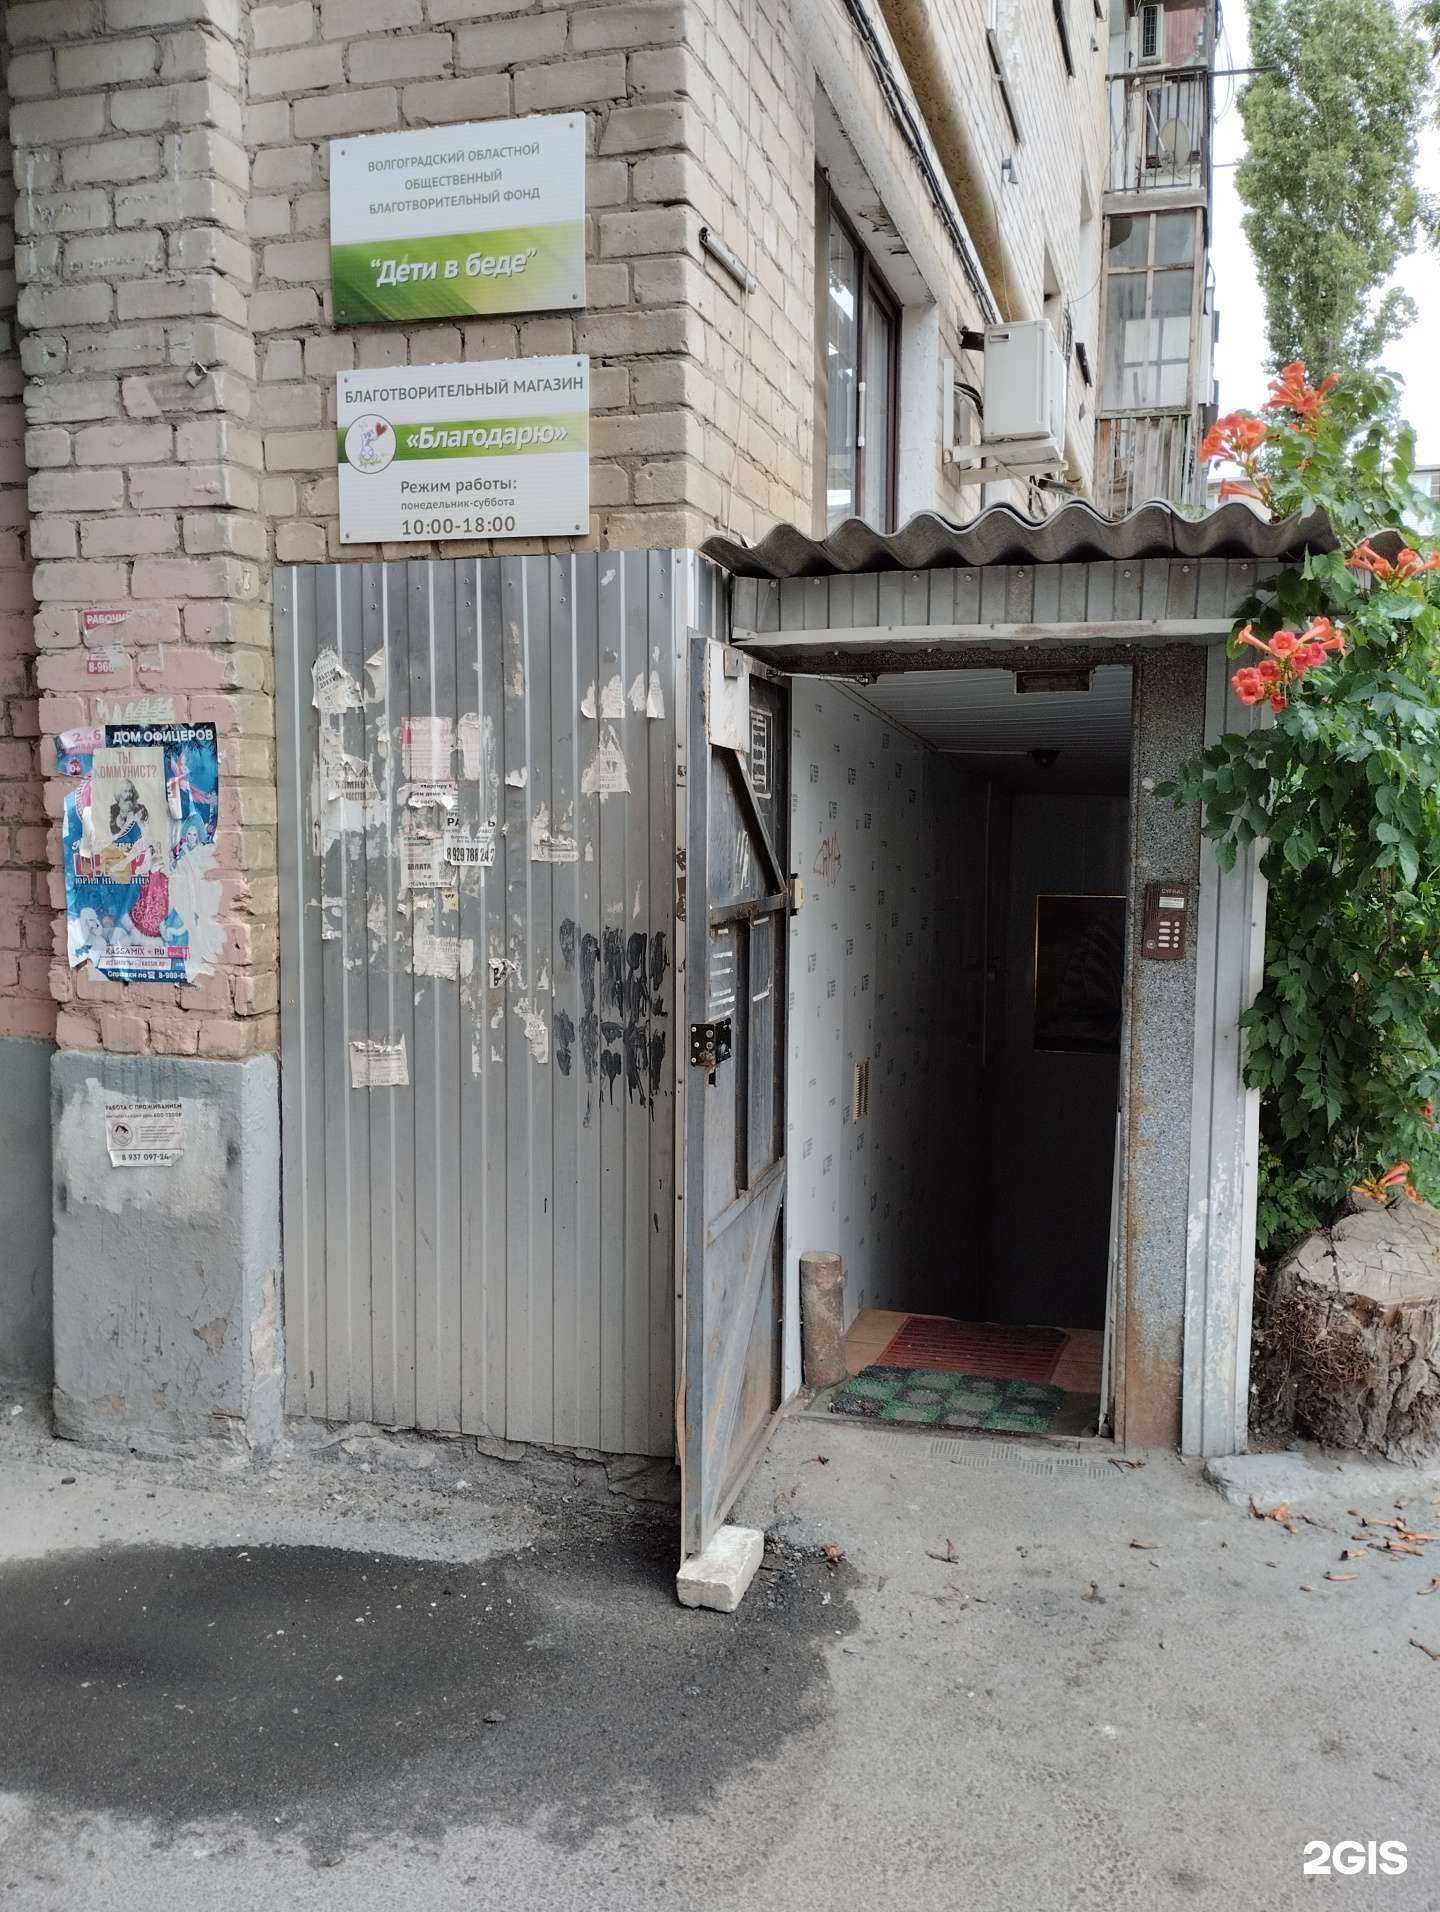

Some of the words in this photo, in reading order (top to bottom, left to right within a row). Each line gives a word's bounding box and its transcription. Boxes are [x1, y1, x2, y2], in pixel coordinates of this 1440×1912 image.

[367, 150, 465, 172] ВОЛГОГРАДСКИЙ
[467, 142, 540, 161] ОБЛАСТНОЙ
[404, 170, 503, 190] ОБЩЕСТВЕННЫЙ
[368, 190, 501, 215] БЛАГОТВОРИТЕЛЬНЫЙ
[503, 187, 541, 201] ФОНД
[444, 259, 459, 279] в
[345, 379, 509, 404] БЛАГОТВОРИТЕЛЬНЫЙ
[513, 376, 584, 393] МАГАЗИН
[406, 424, 569, 449] «Благодарю»
[400, 479, 451, 493] Режим
[455, 477, 517, 500] работы:
[400, 497, 515, 511] понедельник-суббота
[401, 515, 516, 535] 10:00-18:00
[112, 731, 141, 744] ДОМ
[144, 729, 214, 743] ОФИЦЕРОВ
[117, 751, 131, 764] ТЫ
